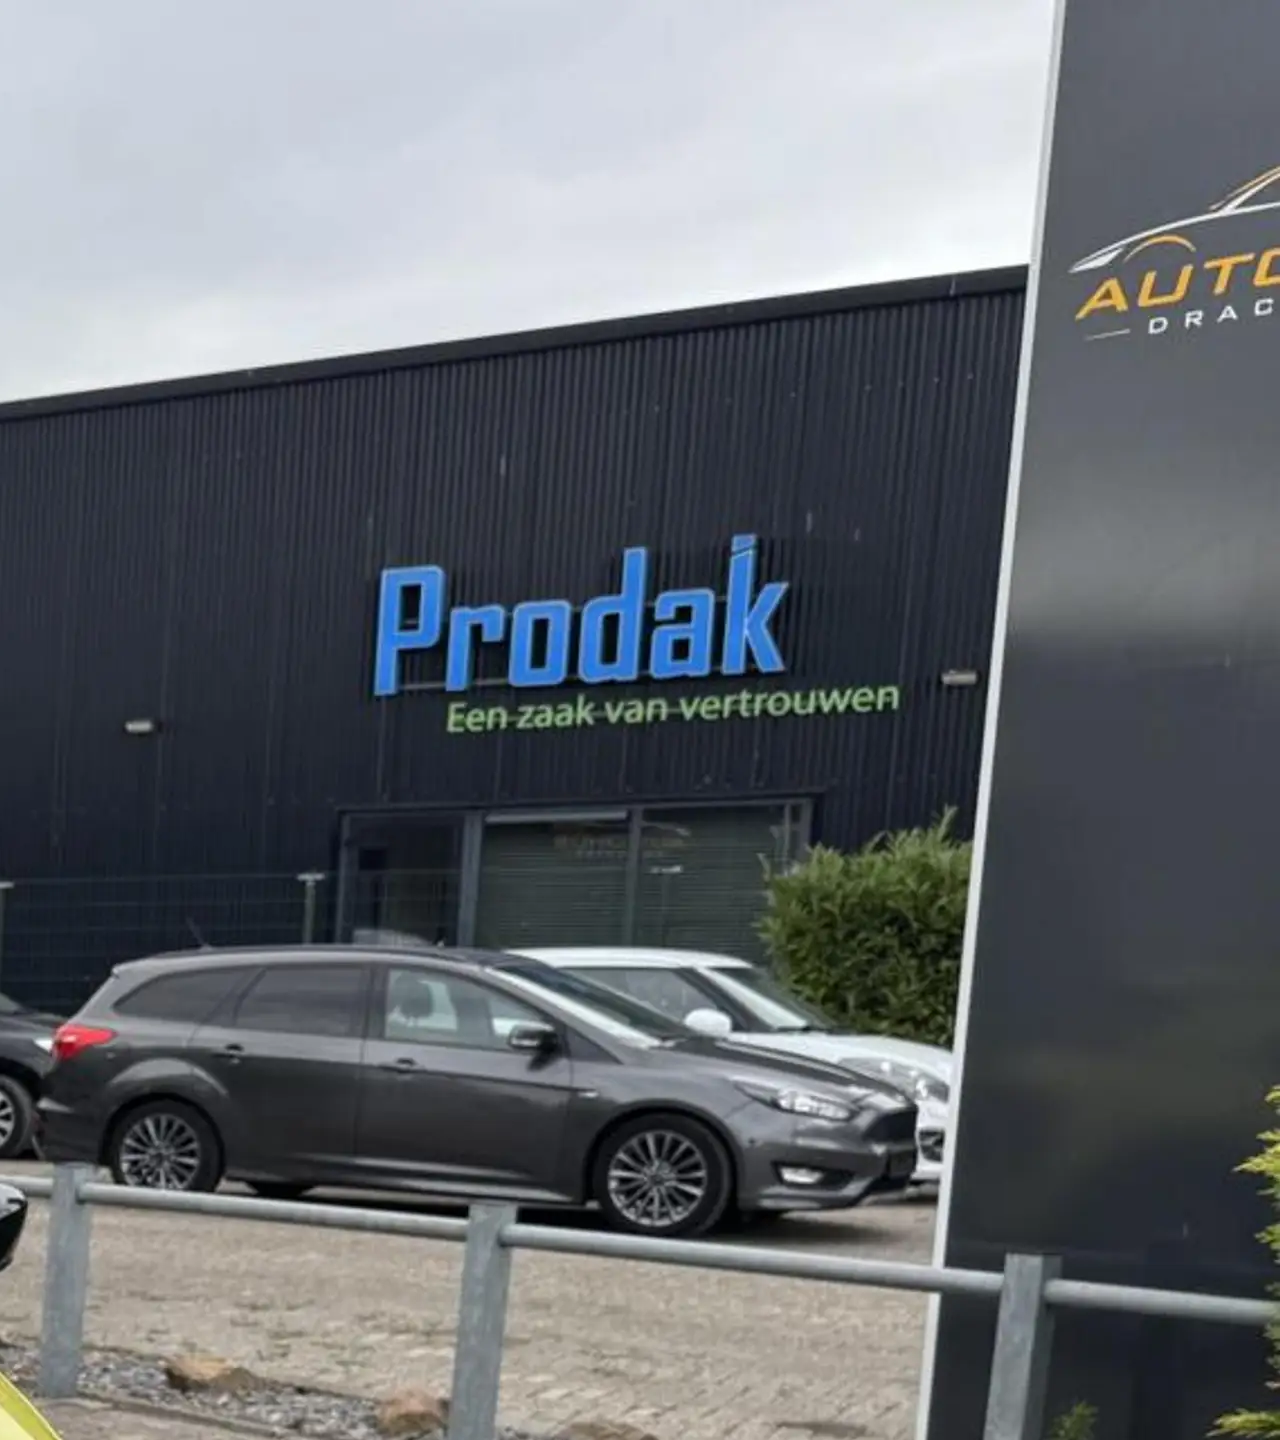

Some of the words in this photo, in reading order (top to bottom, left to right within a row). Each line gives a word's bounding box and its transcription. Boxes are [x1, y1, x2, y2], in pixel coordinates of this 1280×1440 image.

[1147, 297, 1275, 335] DRAC
[373, 533, 790, 696] Prodak
[446, 700, 509, 733] Een
[516, 692, 594, 730] zaak
[604, 696, 669, 725] van
[679, 684, 901, 722] vertrouwen
